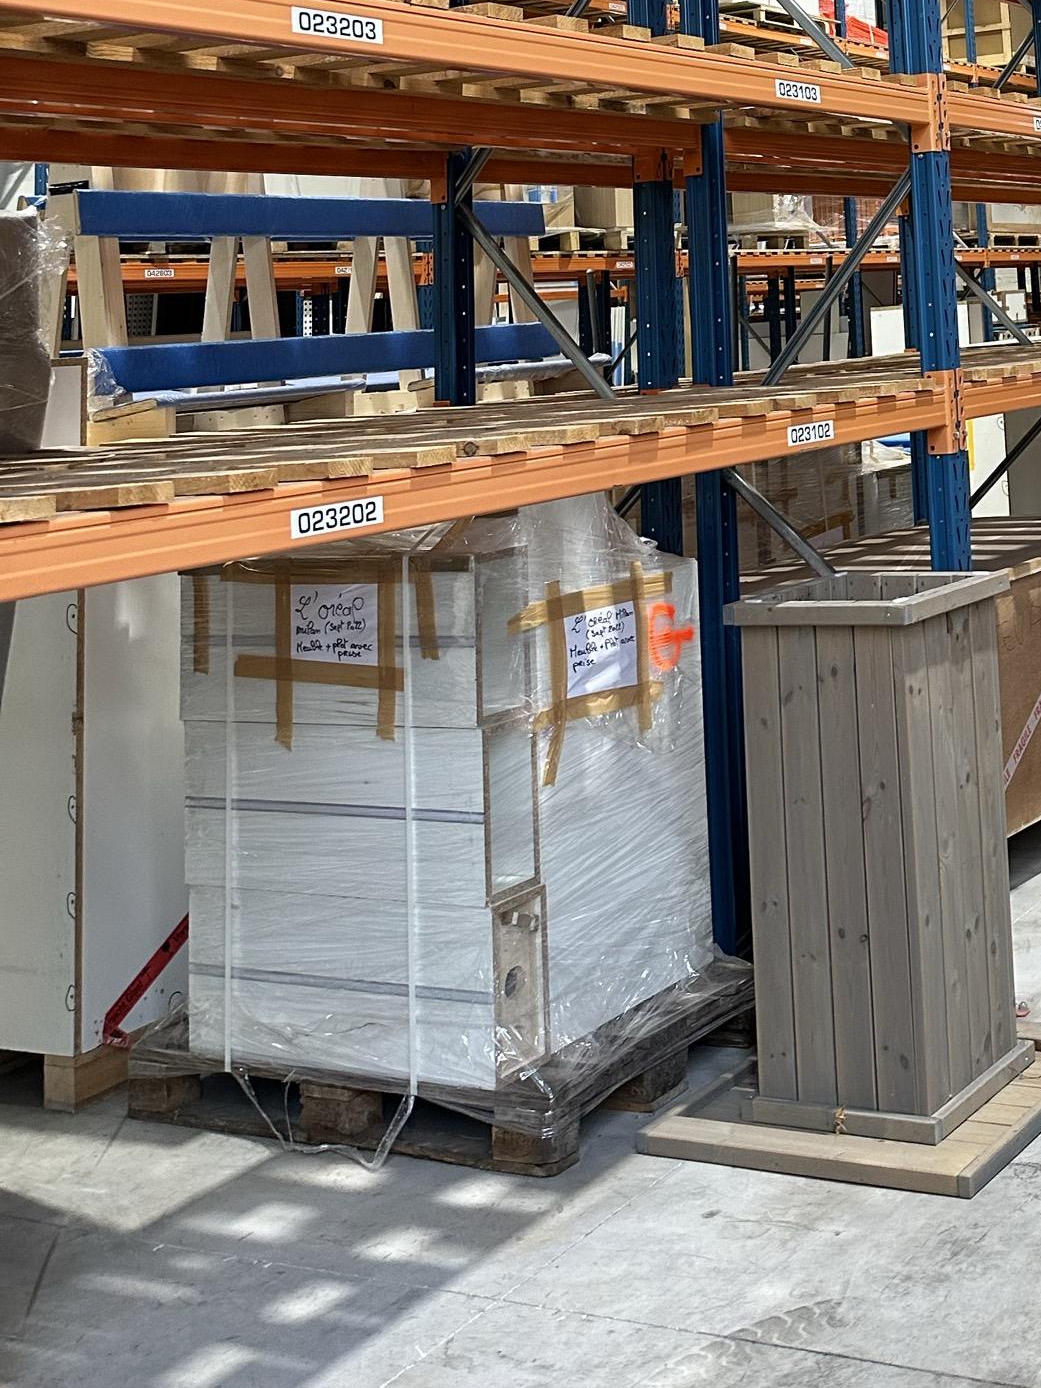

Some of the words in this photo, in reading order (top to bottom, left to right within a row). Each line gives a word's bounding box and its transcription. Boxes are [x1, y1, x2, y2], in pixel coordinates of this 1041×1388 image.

[299, 11, 377, 40] 023203
[779, 82, 817, 101] 023103
[790, 423, 831, 443] 023102
[298, 501, 377, 534] 023202
[1013, 724, 1033, 764] FRAGILE
